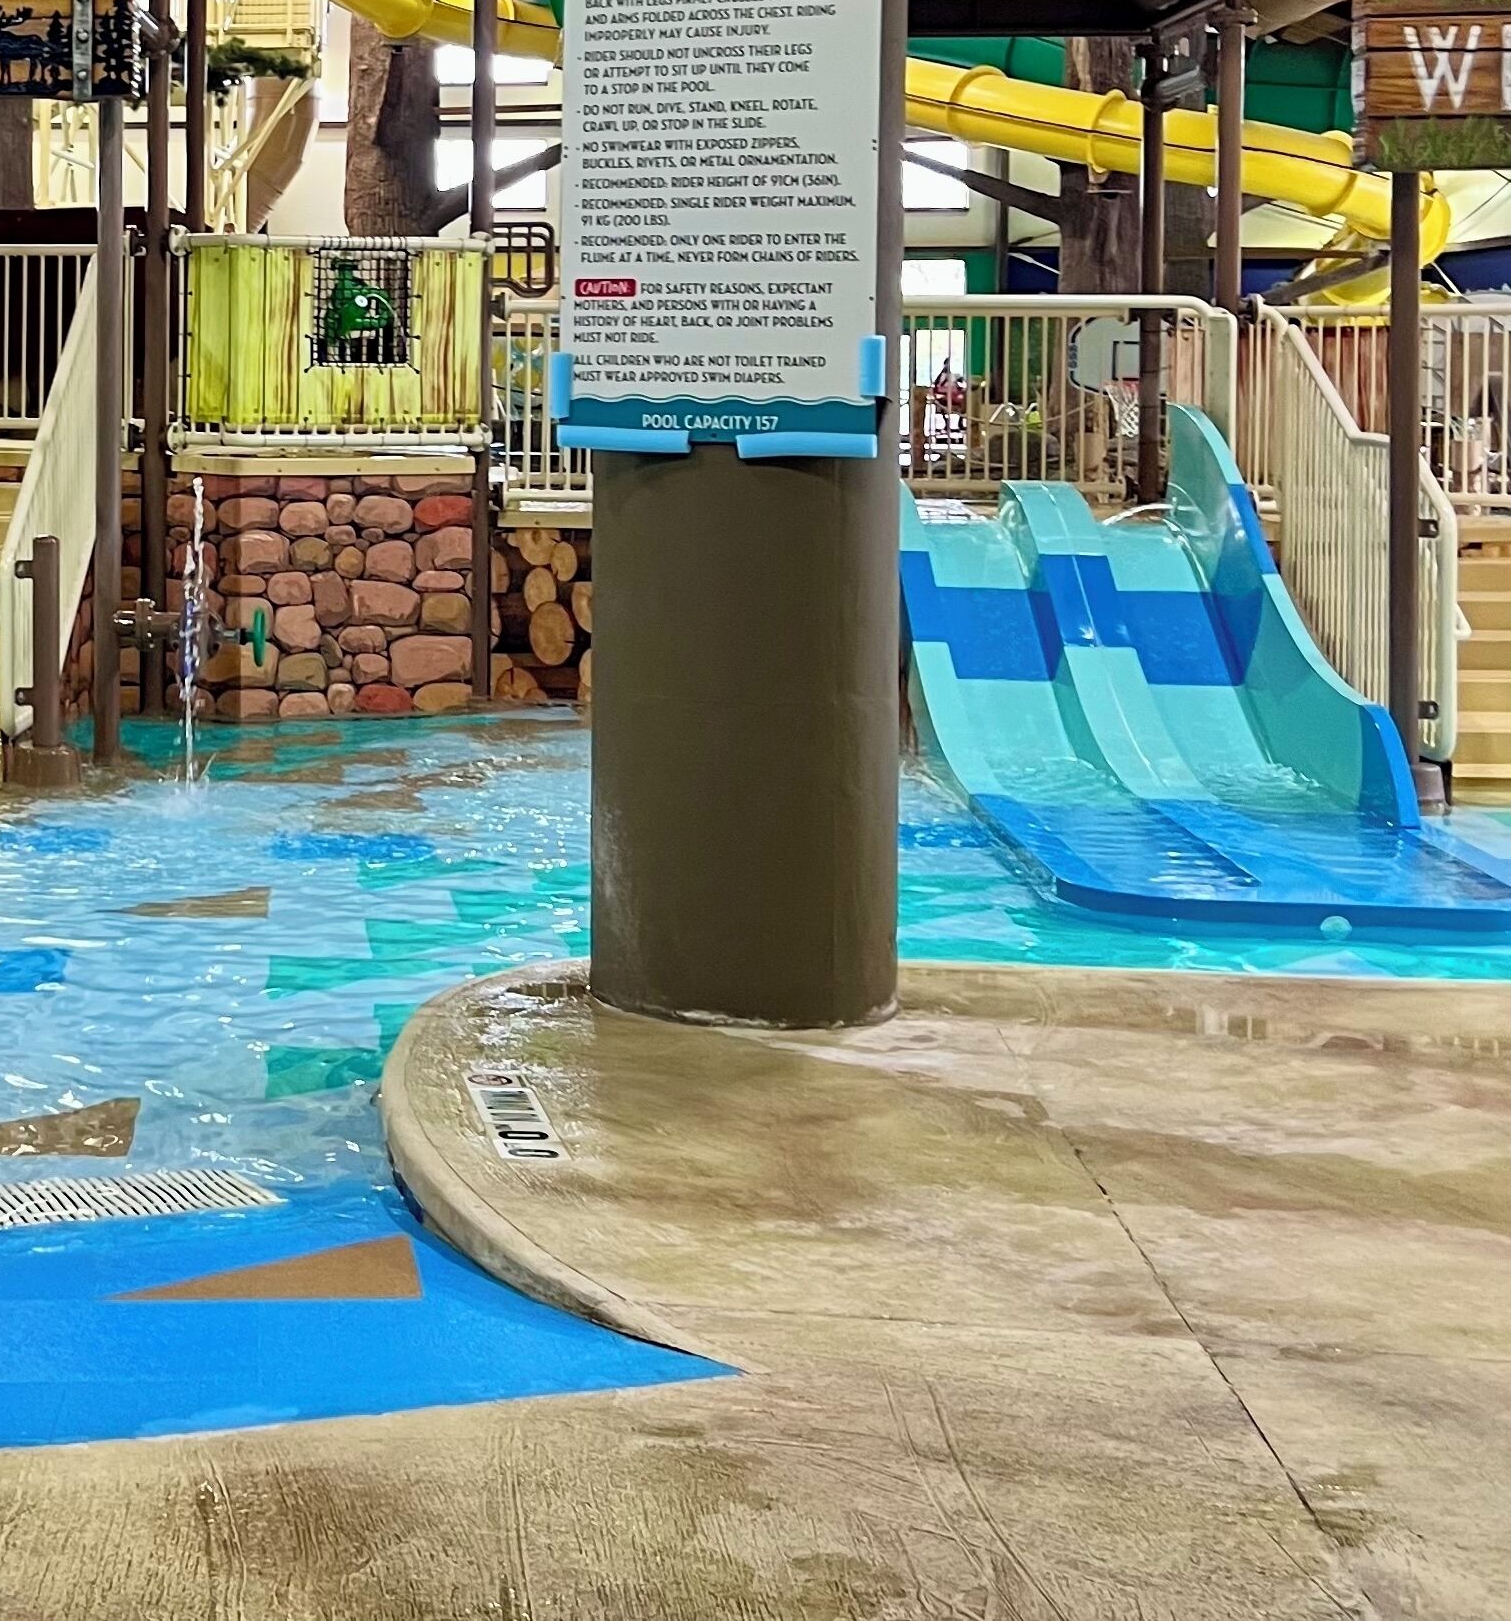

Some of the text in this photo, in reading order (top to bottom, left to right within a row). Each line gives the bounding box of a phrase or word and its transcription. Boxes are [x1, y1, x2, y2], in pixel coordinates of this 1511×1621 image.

[584, 4, 836, 25] AND ARMS FOLDED ACROSS THE RIDING
[584, 25, 722, 42] IMPROPERLY MAY CAUSE
[584, 42, 812, 61] RIDER SHOULD NOT UNCROSS THEIR LEGS
[583, 60, 809, 78] OR ATTEMPT TO SIT UP UNTIL THEY COME
[583, 81, 677, 95] TO STOP THE
[582, 103, 624, 115] DO NOT
[582, 117, 728, 132] CRAWL OR STOP THE
[582, 137, 748, 152] NO SWIMWEAR WITH EXPOSED
[679, 154, 735, 167] OR METAL
[670, 174, 799, 188] RIDER HEIGHT OF 91CM
[670, 195, 794, 208] SINGLE RIDER WEIGHT
[596, 214, 611, 226] KG
[669, 232, 846, 245] ONLY ONE RIDER TO ENTER THE
[580, 250, 812, 263] FLUME NEVER FORM CHAINS OF
[640, 282, 832, 294] FOR SAFETY EXPECTANT
[630, 299, 806, 310] AND PERSONS WITH OR HAVING
[573, 315, 833, 327] HISTORY OF OR JOINT PROBLEMS
[573, 332, 602, 343] MUST
[603, 332, 628, 343] NOT
[573, 353, 826, 367] ALL CHILDREN WHO ARE NOT TOILET TRAINED
[572, 370, 731, 383] MUST WEAR APPROVED SWIM
[641, 413, 778, 430] POOL CAPACITY 157
